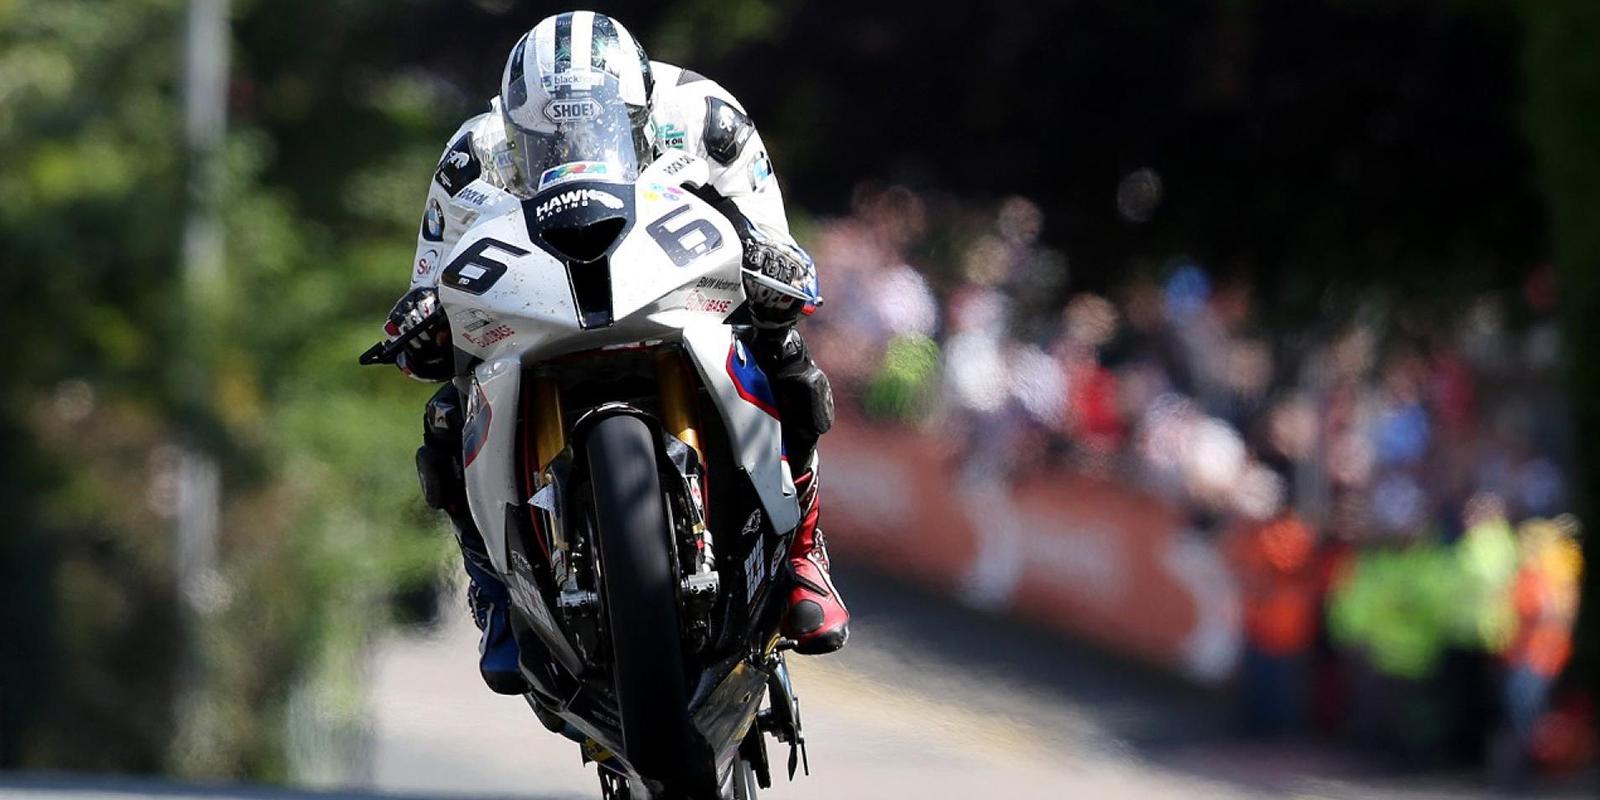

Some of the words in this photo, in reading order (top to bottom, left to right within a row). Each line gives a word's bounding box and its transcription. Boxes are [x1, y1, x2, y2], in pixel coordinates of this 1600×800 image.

[536, 188, 600, 218] HAWK
[538, 200, 589, 222] RACING
[645, 203, 724, 267] 6
[441, 237, 532, 296] 6
